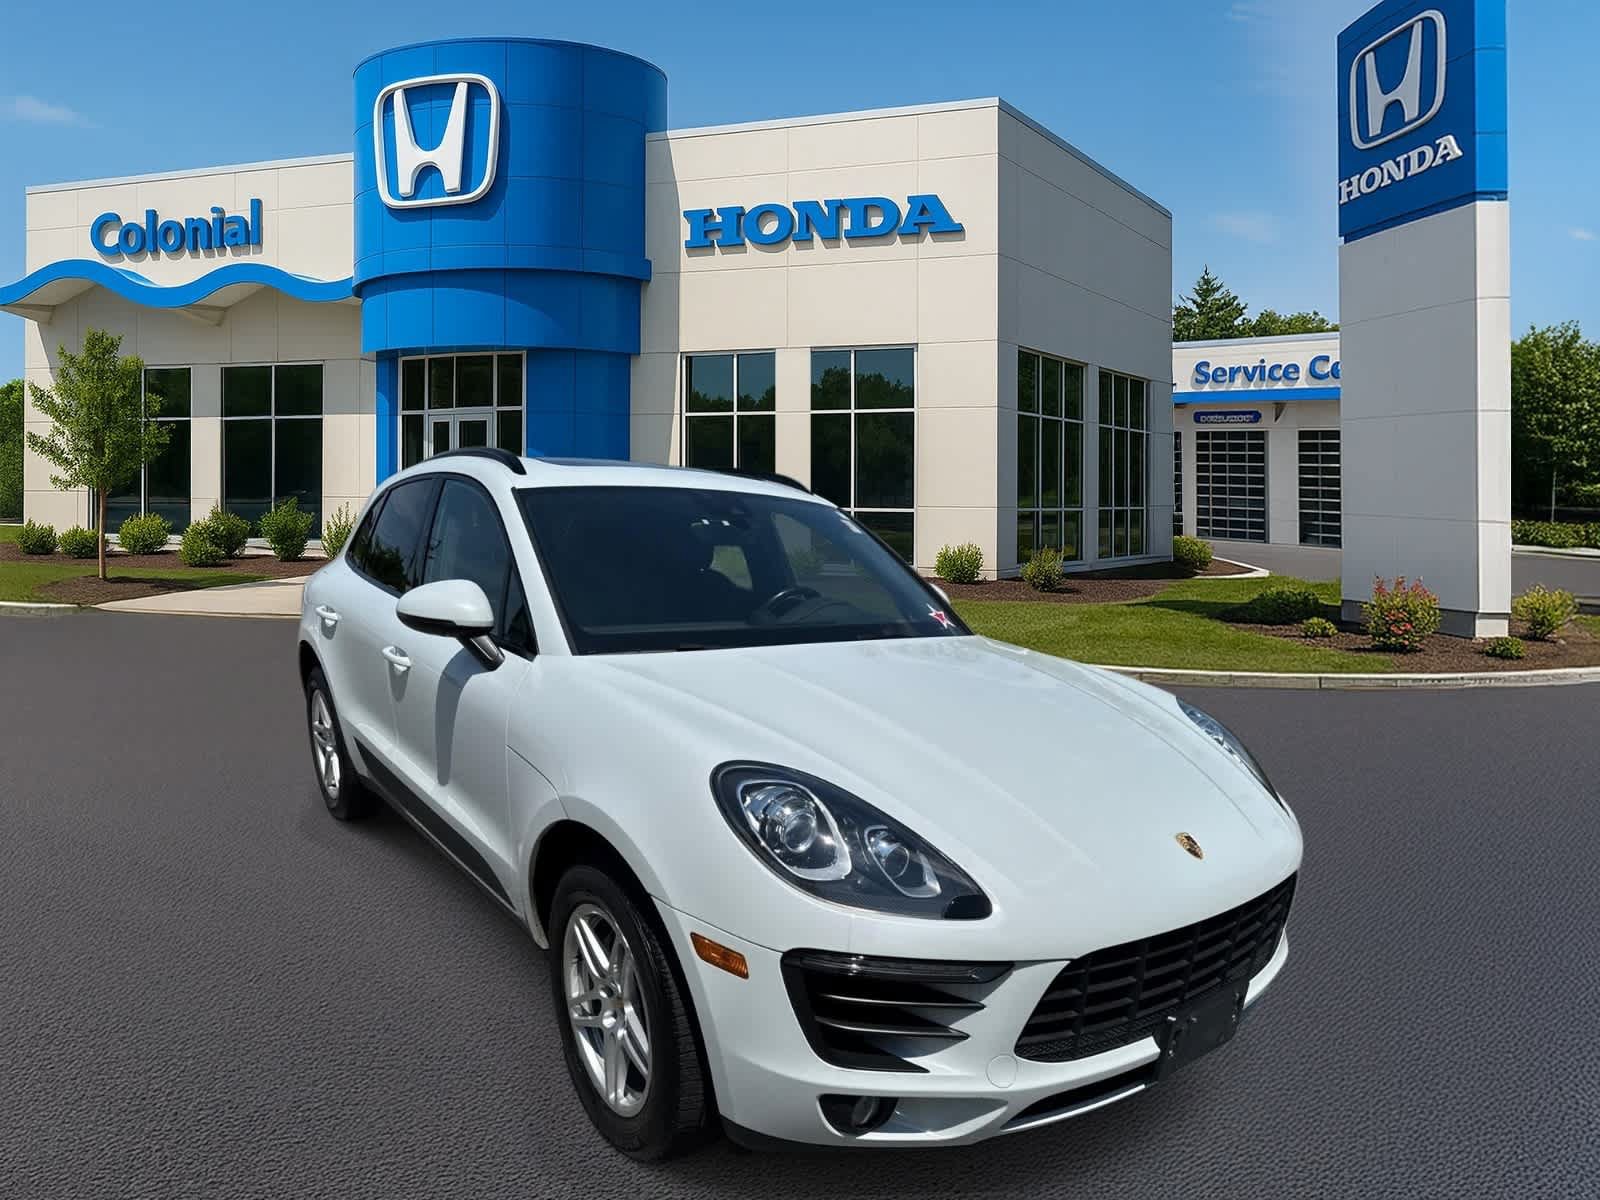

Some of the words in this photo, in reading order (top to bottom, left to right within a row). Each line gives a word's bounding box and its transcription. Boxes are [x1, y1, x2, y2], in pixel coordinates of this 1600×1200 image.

[1339, 134, 1463, 204] HONDA
[90, 198, 262, 256] Colonial
[683, 194, 964, 249] HONDA
[1194, 358, 1300, 384] Service
